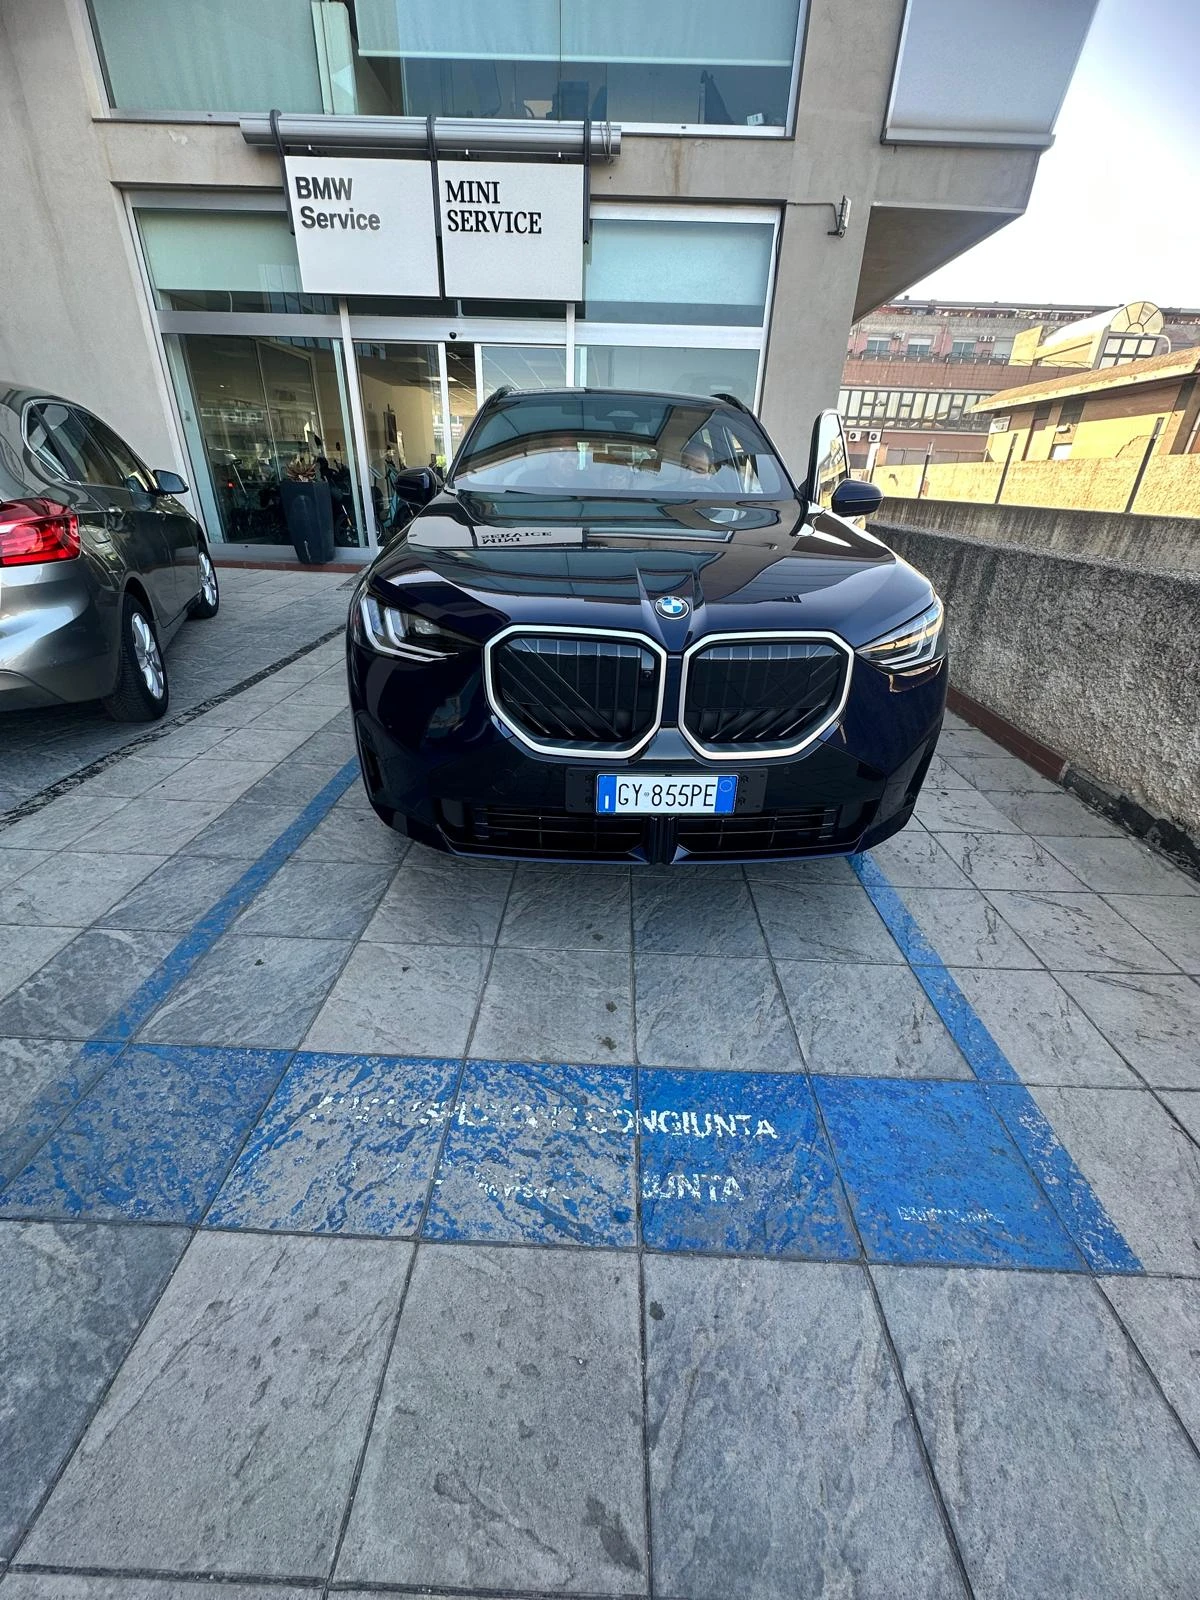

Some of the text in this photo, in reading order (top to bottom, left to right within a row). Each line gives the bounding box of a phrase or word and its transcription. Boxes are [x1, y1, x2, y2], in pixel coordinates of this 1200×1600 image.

[295, 176, 352, 201] BMW
[445, 180, 500, 204] MINI
[301, 206, 381, 231] Service
[447, 209, 542, 234] SERVICE
